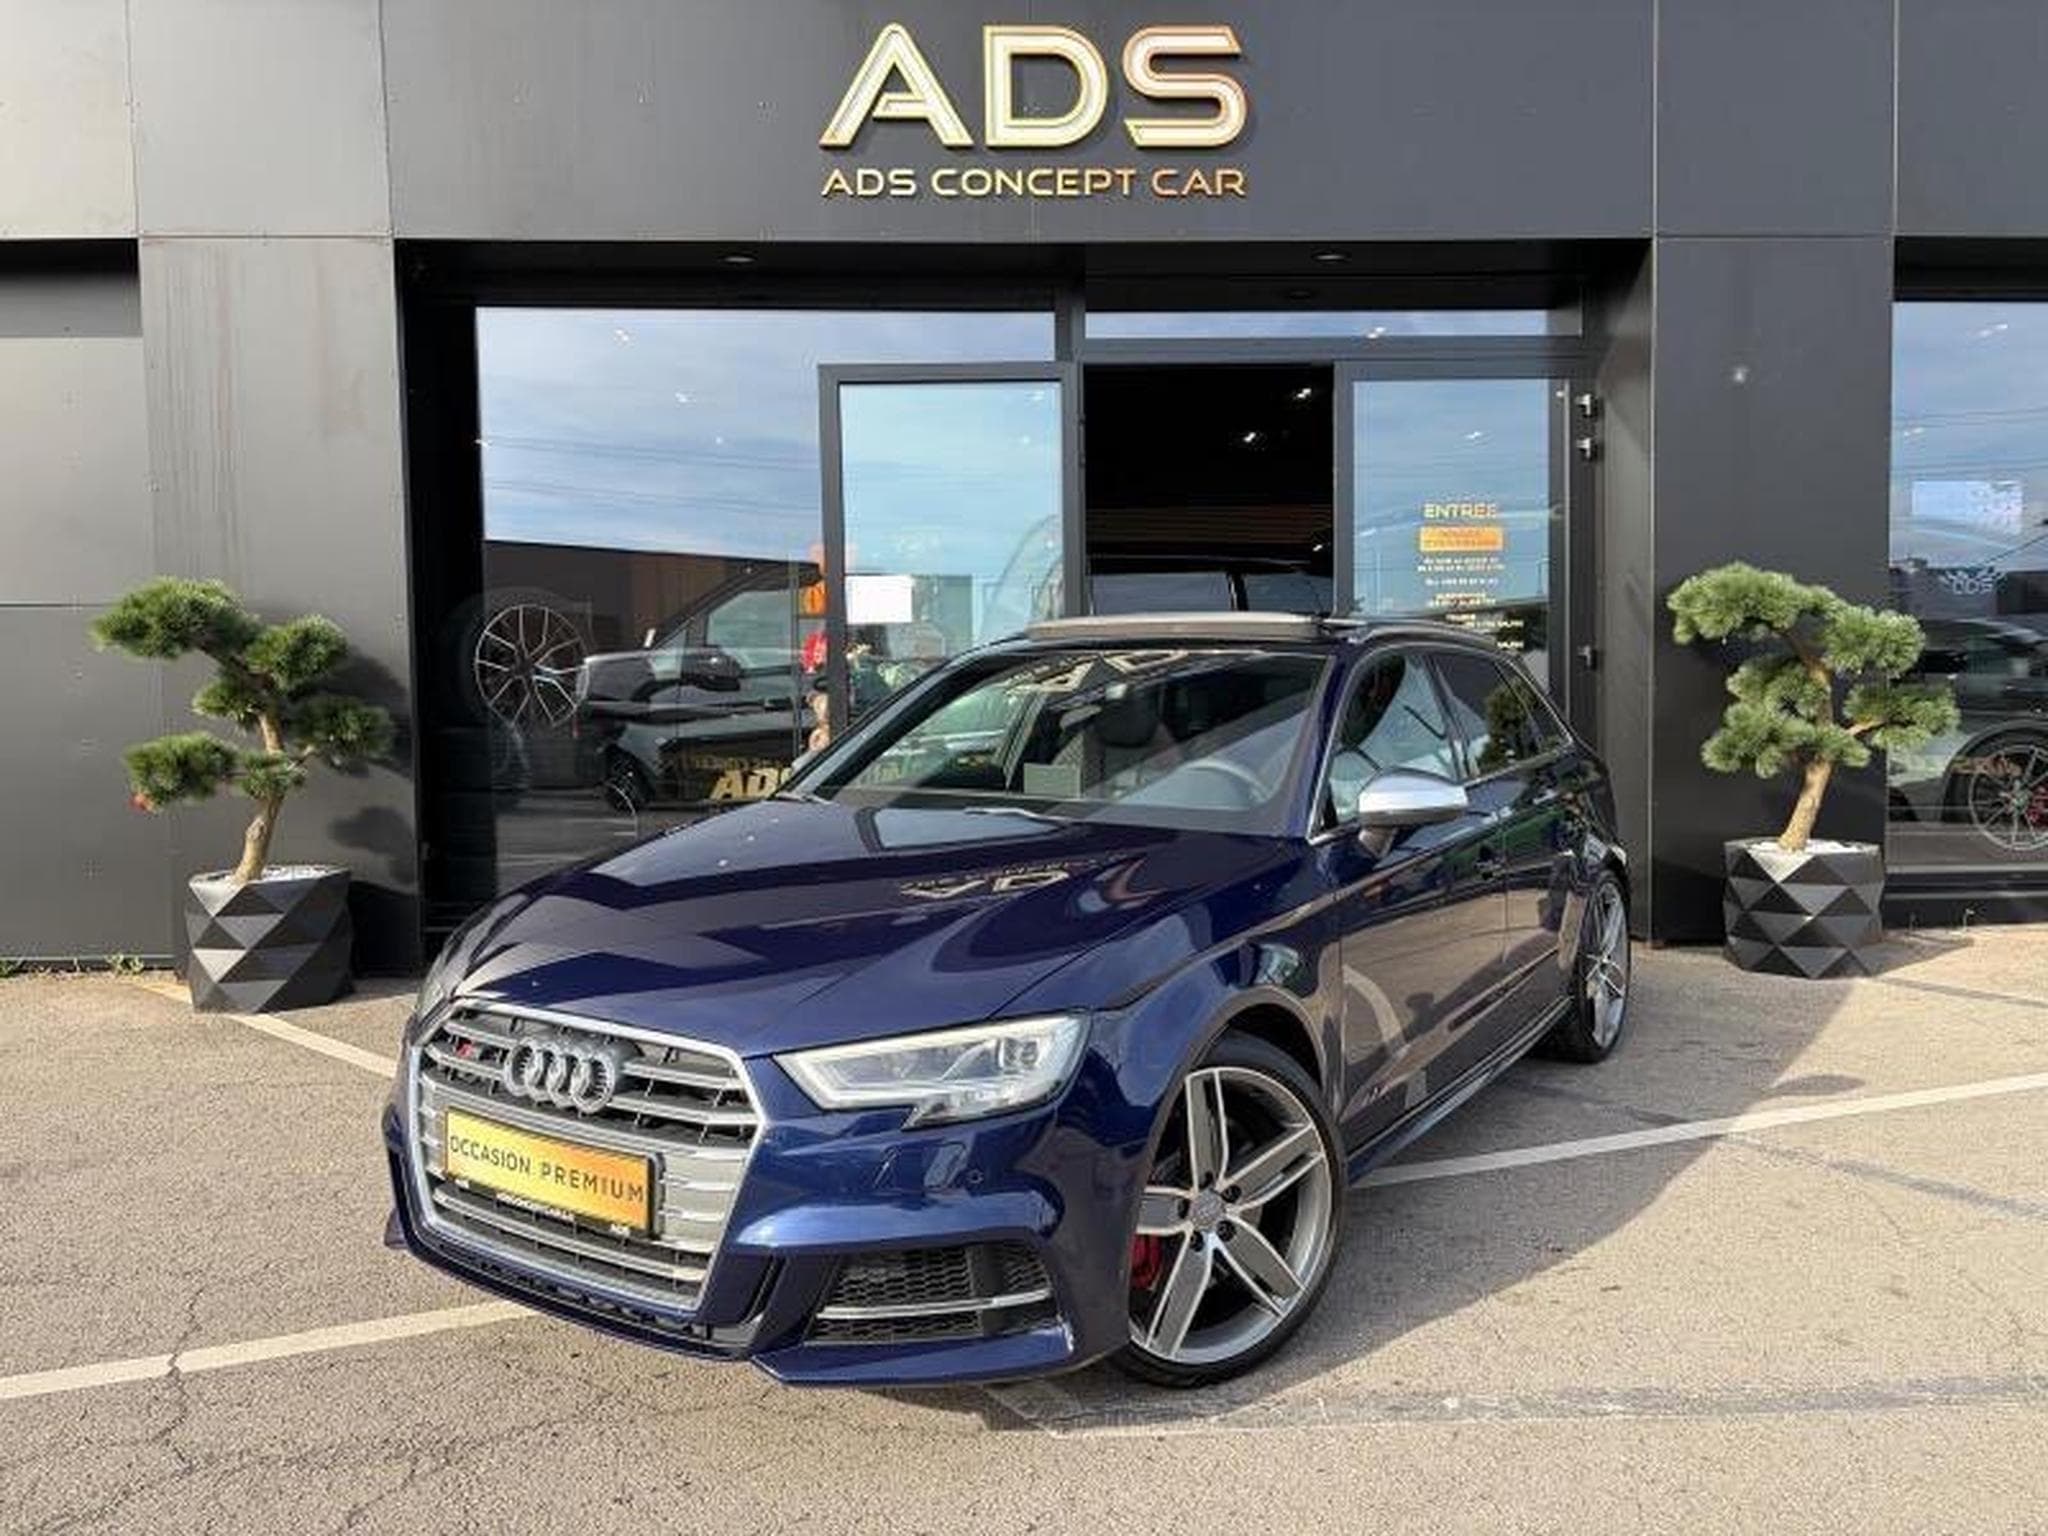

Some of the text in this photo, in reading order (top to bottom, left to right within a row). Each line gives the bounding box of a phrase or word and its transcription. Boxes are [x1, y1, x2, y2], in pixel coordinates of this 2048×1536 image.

[819, 22, 1248, 148] ADS
[821, 168, 1246, 197] ADS CONCEPT CAR
[450, 1134, 644, 1203] OCCASION PREMIUM
